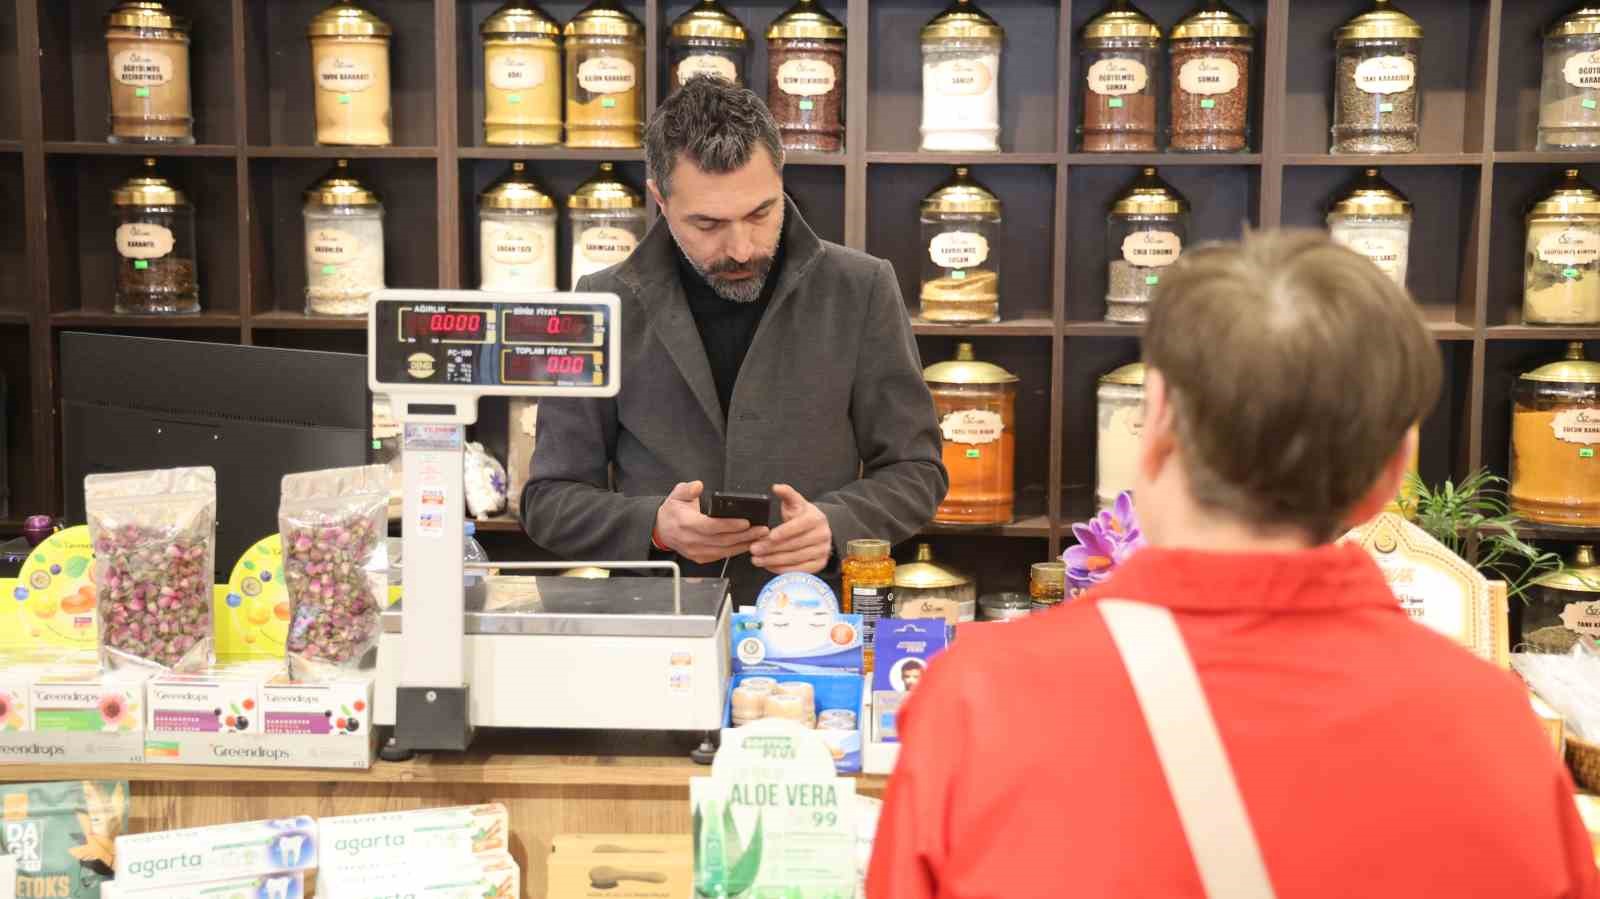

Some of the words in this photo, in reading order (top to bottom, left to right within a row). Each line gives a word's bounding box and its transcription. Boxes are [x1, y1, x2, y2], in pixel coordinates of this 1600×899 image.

[0, 744, 65, 758] reendrops
[730, 784, 779, 806] ALOE
[786, 784, 838, 806] VERA
[812, 812, 838, 827] 99
[334, 834, 405, 856] agarta
[128, 854, 202, 878] agarta
[16, 875, 70, 898] ETOKS
